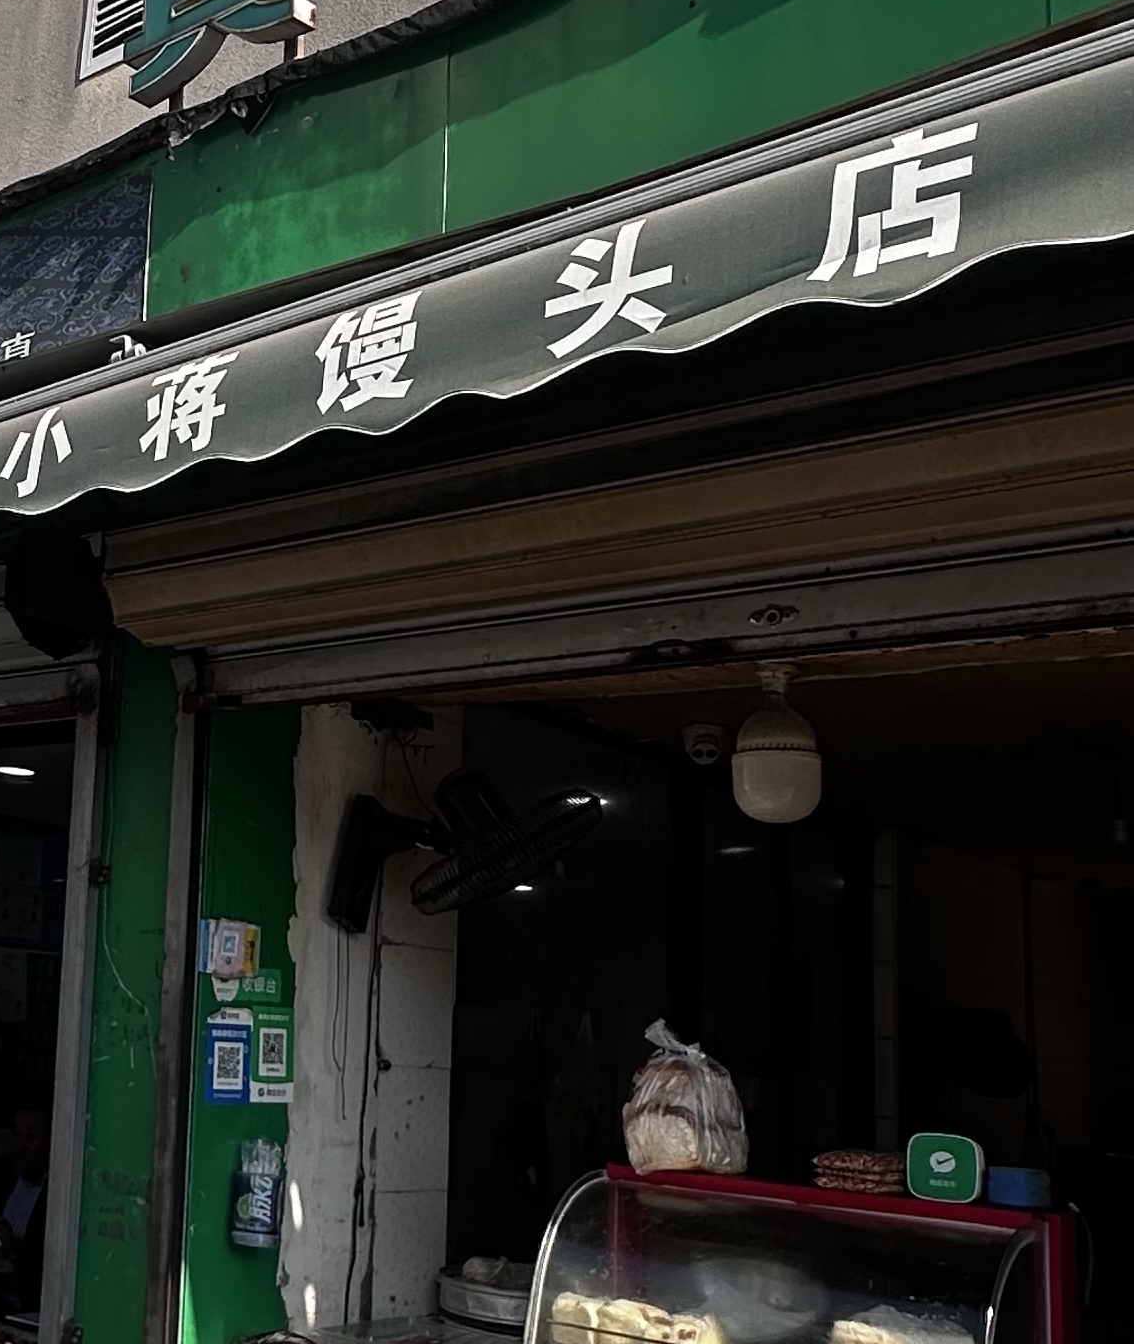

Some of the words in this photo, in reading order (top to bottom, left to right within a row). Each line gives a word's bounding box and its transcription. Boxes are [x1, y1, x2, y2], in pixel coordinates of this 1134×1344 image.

[0, 120, 978, 498] 小蒋馒头店
[242, 976, 277, 994] 收银台
